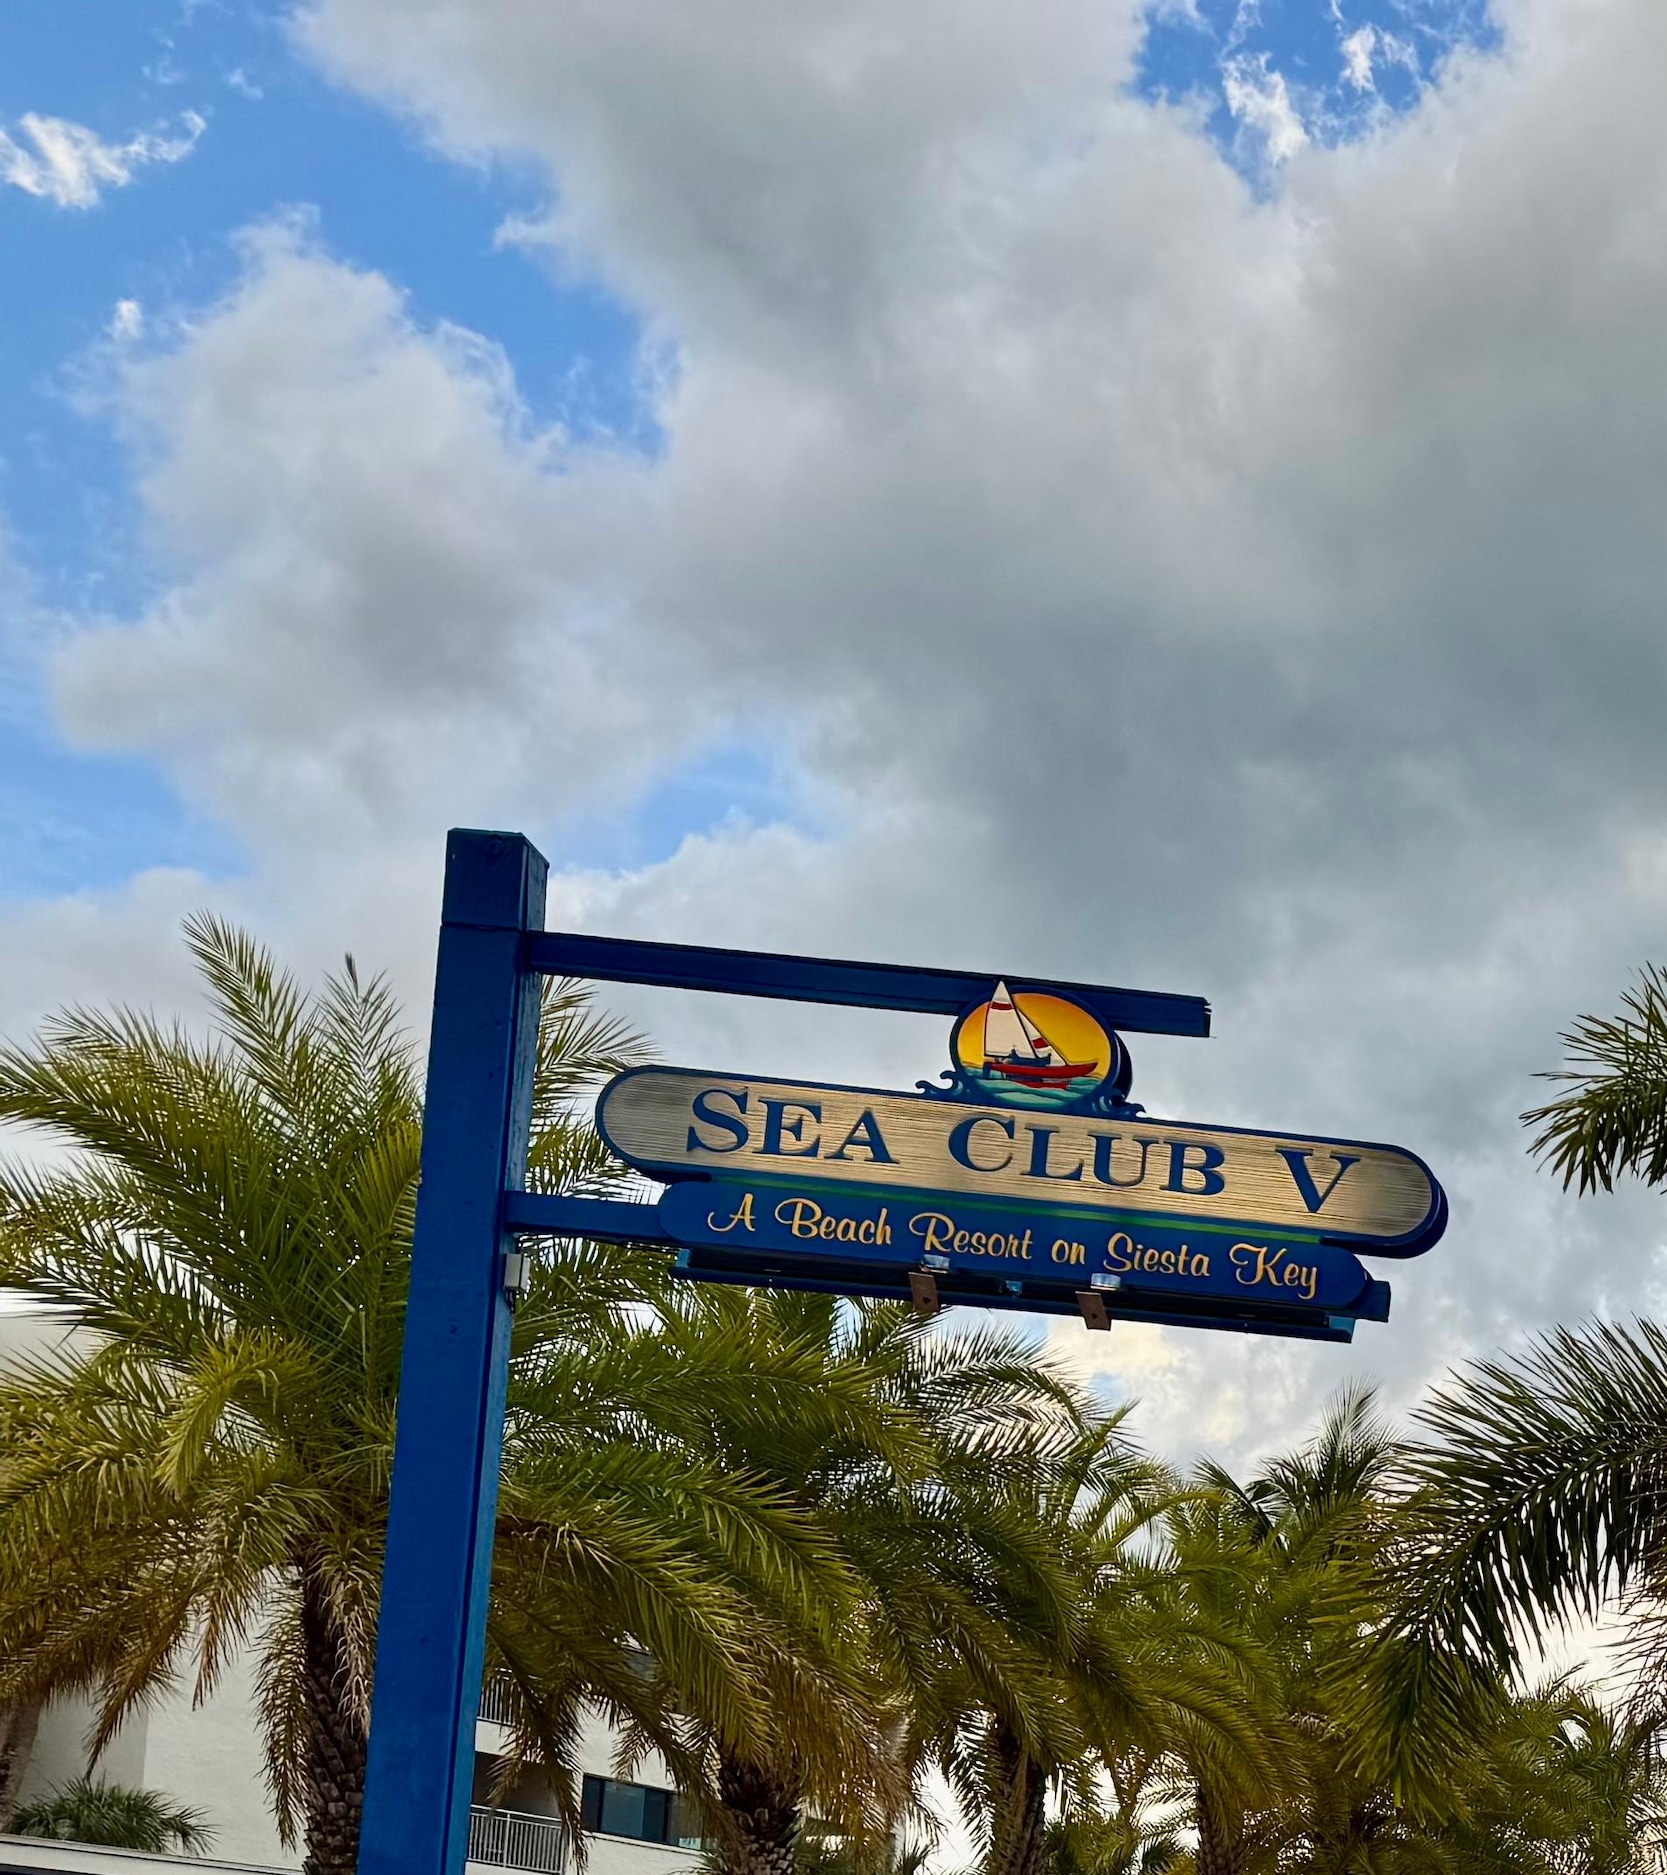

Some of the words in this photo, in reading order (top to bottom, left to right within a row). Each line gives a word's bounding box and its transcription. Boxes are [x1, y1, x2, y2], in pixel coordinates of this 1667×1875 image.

[687, 1087, 899, 1164] SEA
[947, 1114, 1226, 1197] CLUB
[1275, 1146, 1362, 1214] V
[707, 1192, 756, 1233] A
[774, 1196, 893, 1246] Beach
[908, 1211, 1034, 1261] Resort
[1050, 1238, 1087, 1265] on
[1101, 1231, 1211, 1278] Siesta
[1228, 1241, 1319, 1301] Key
